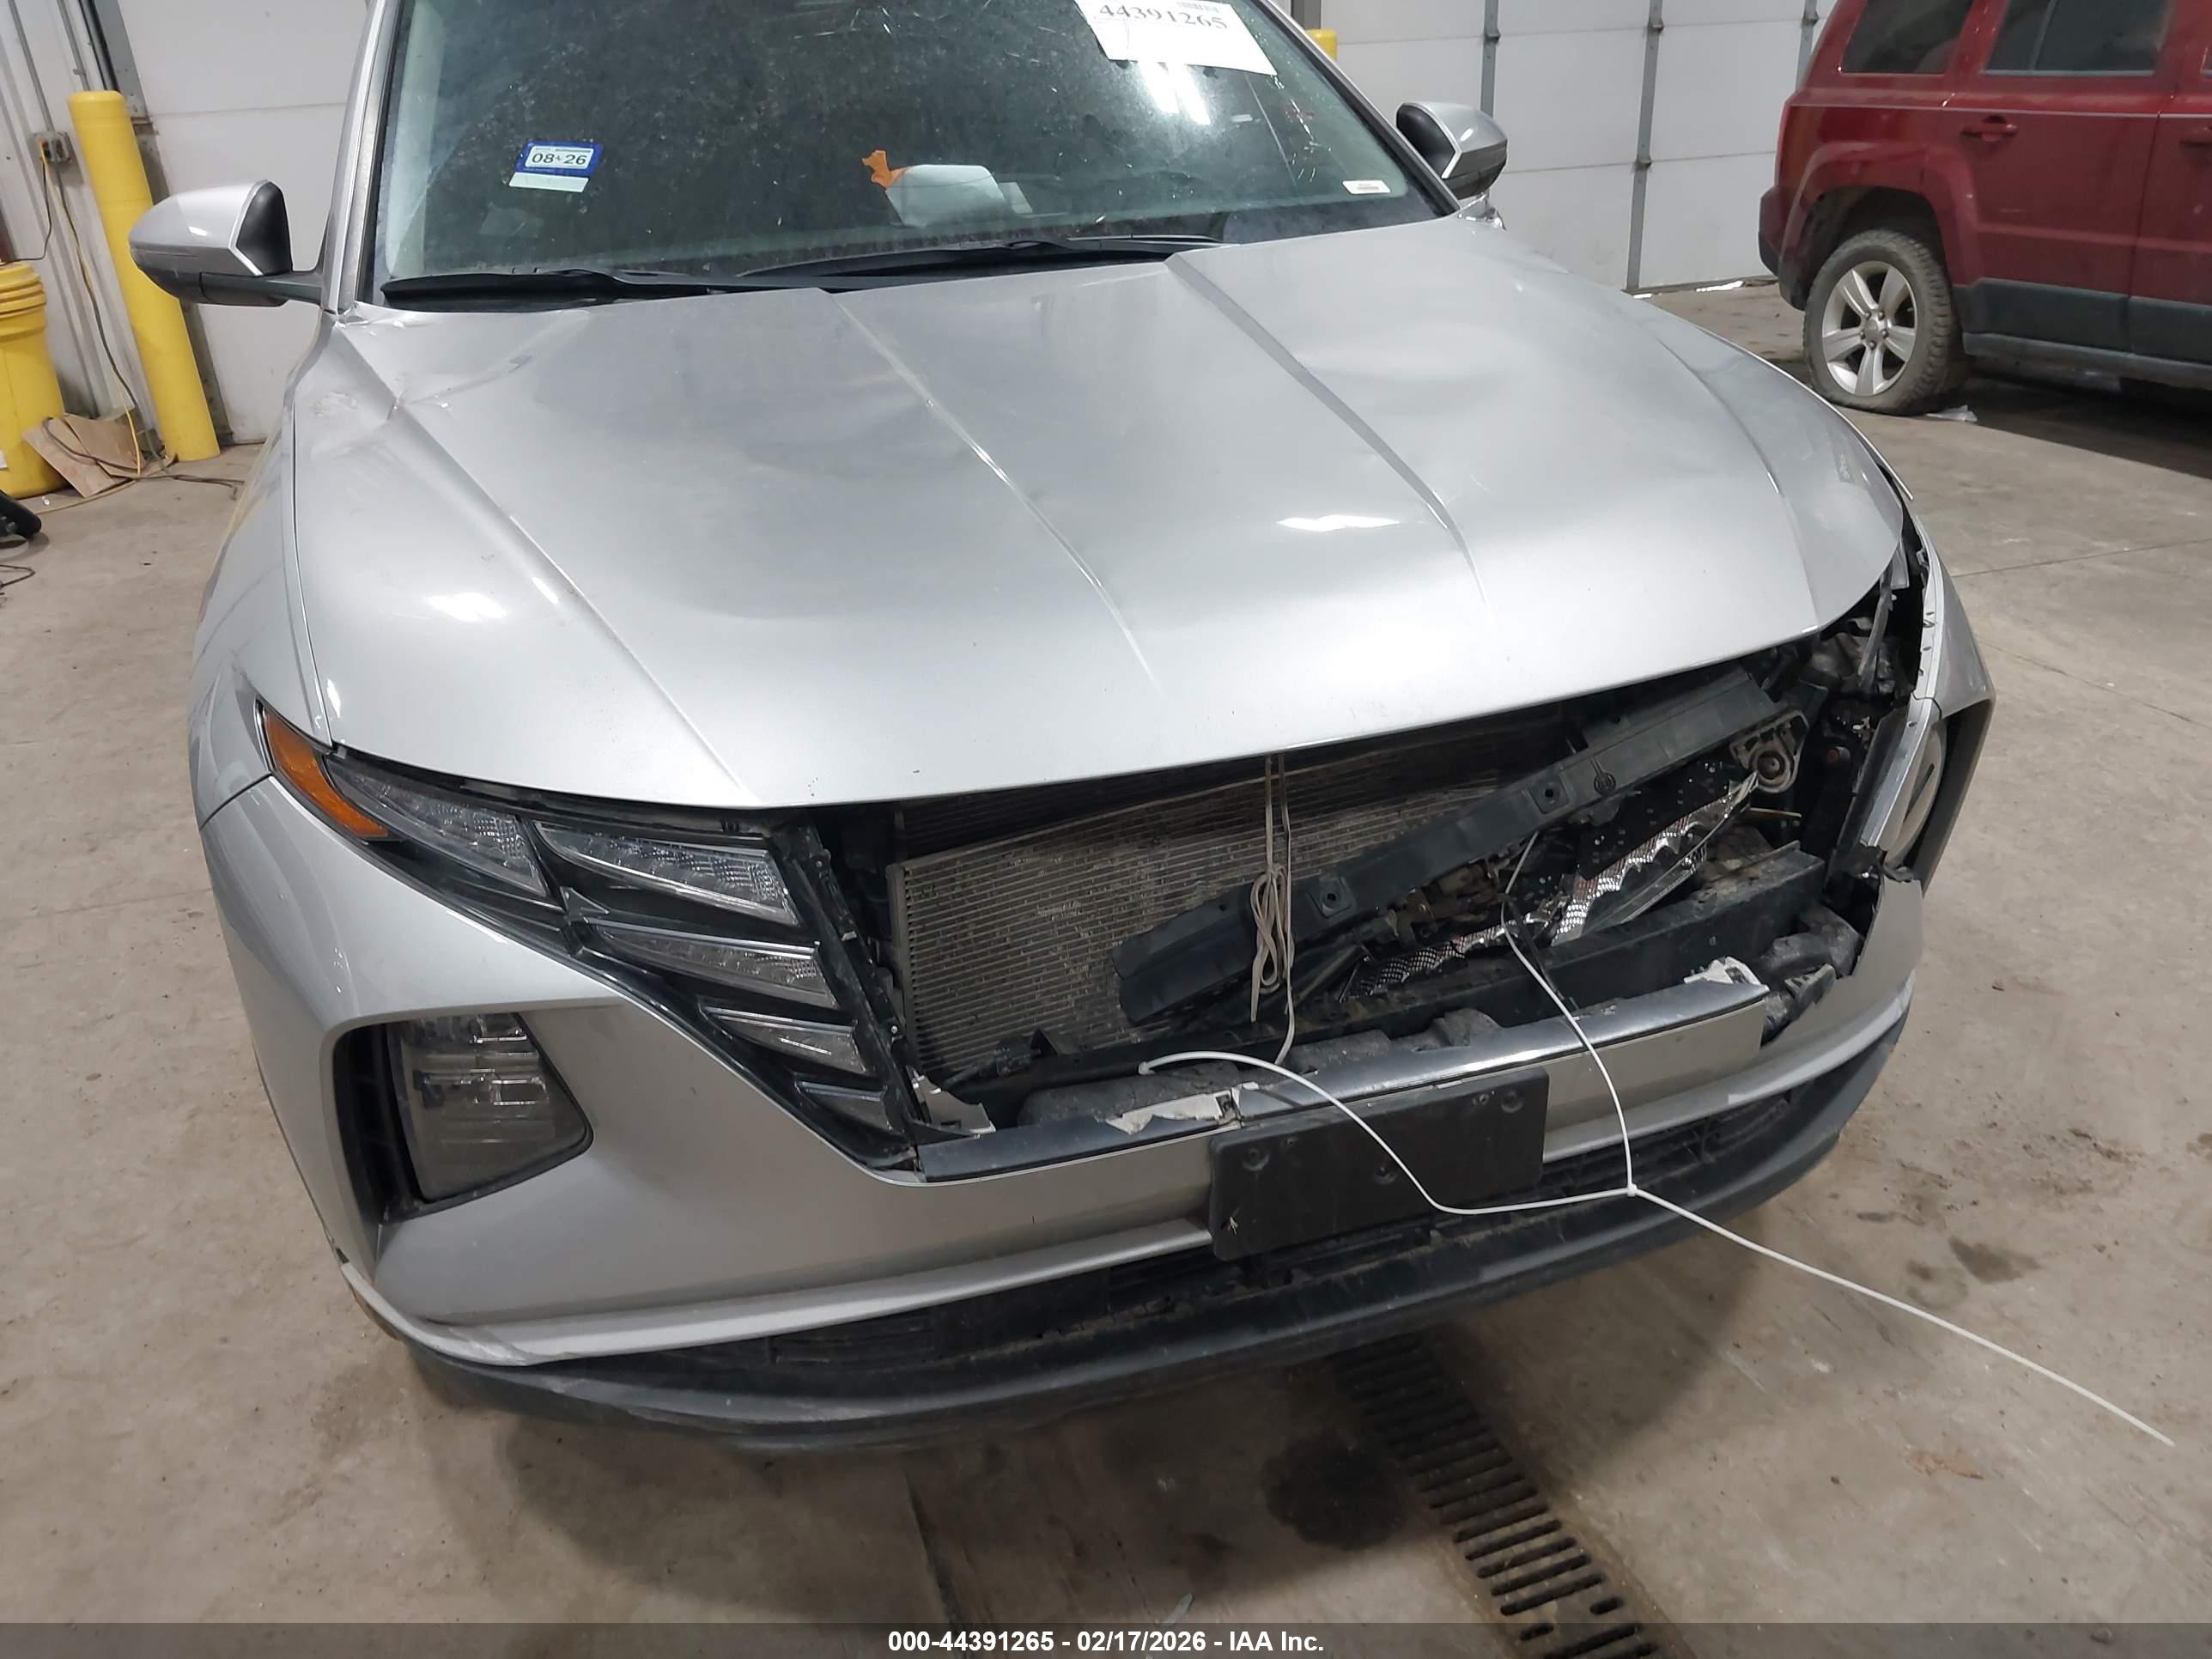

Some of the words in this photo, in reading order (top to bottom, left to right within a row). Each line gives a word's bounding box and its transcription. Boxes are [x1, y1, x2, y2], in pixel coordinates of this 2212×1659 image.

[1099, 4, 1228, 29] 44391265
[532, 153, 555, 164] 08
[563, 154, 588, 165] 26
